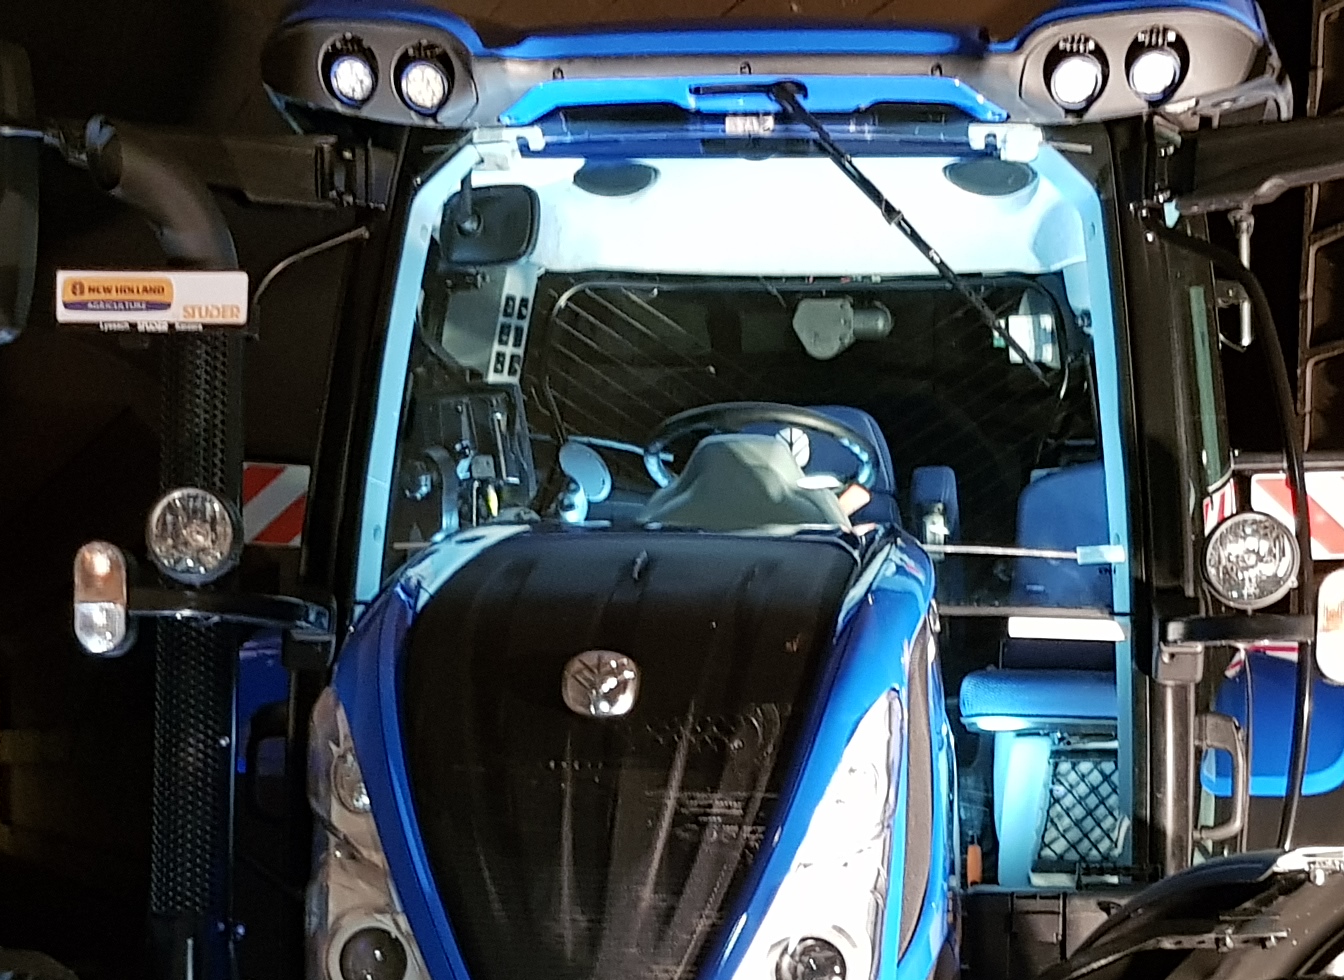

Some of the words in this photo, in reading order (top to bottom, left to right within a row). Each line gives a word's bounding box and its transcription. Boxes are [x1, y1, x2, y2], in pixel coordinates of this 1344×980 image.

[88, 286, 113, 294] NEW
[115, 286, 165, 295] HOLLAND
[182, 304, 241, 319] STUDER
